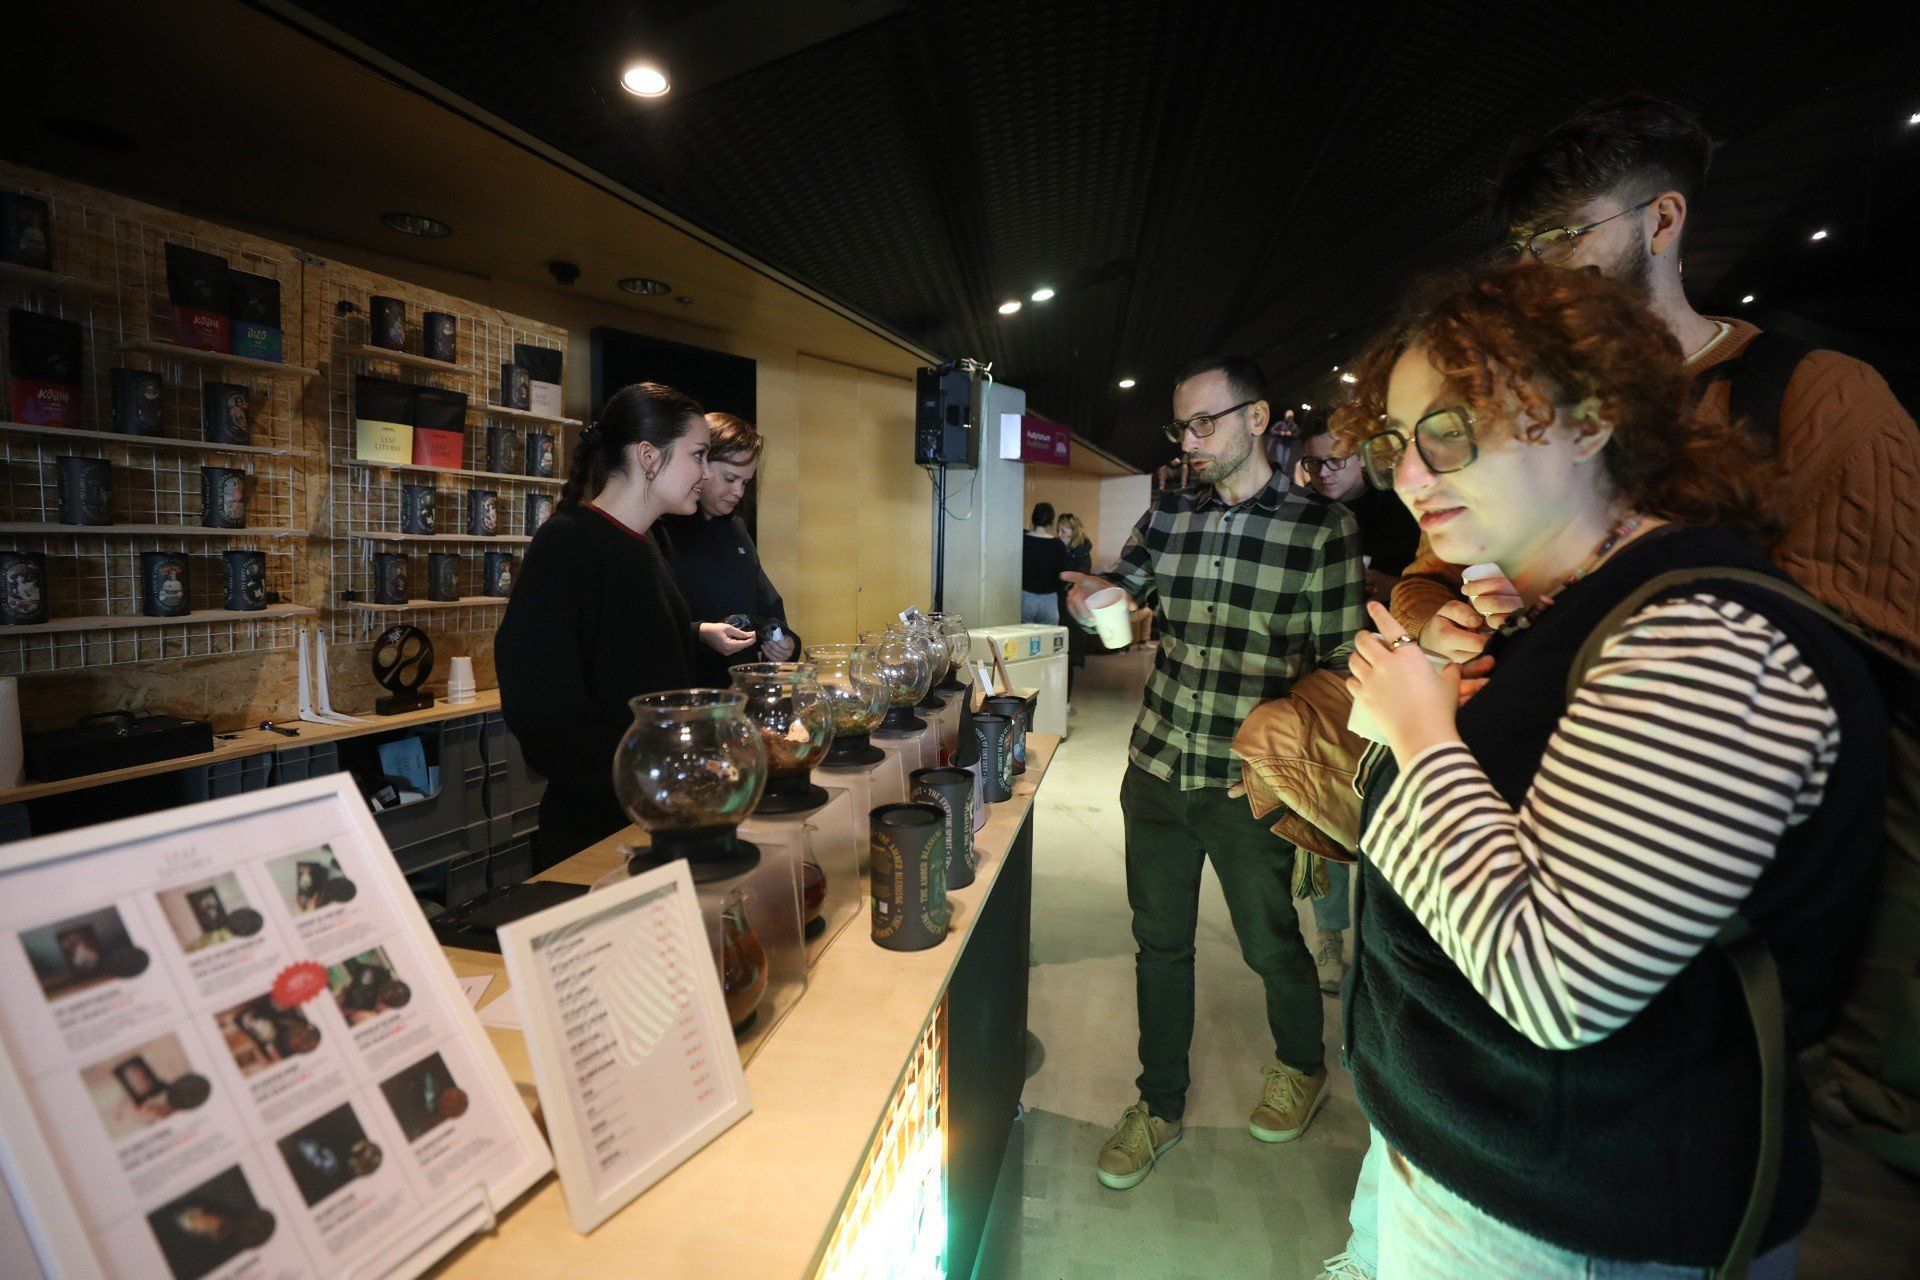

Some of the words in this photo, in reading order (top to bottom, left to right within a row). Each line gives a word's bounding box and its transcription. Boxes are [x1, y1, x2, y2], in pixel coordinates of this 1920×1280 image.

[374, 443, 401, 452] LITURGY
[381, 436, 396, 444] LEAF
[927, 788, 941, 800] THE
[939, 797, 952, 829] EVENTIDE
[944, 829, 953, 850] SPIRIT
[889, 844, 903, 870] AMBER
[920, 862, 928, 887] AMBER
[895, 872, 904, 904] BLESSING
[920, 889, 928, 904] THE
[891, 914, 903, 929] THE
